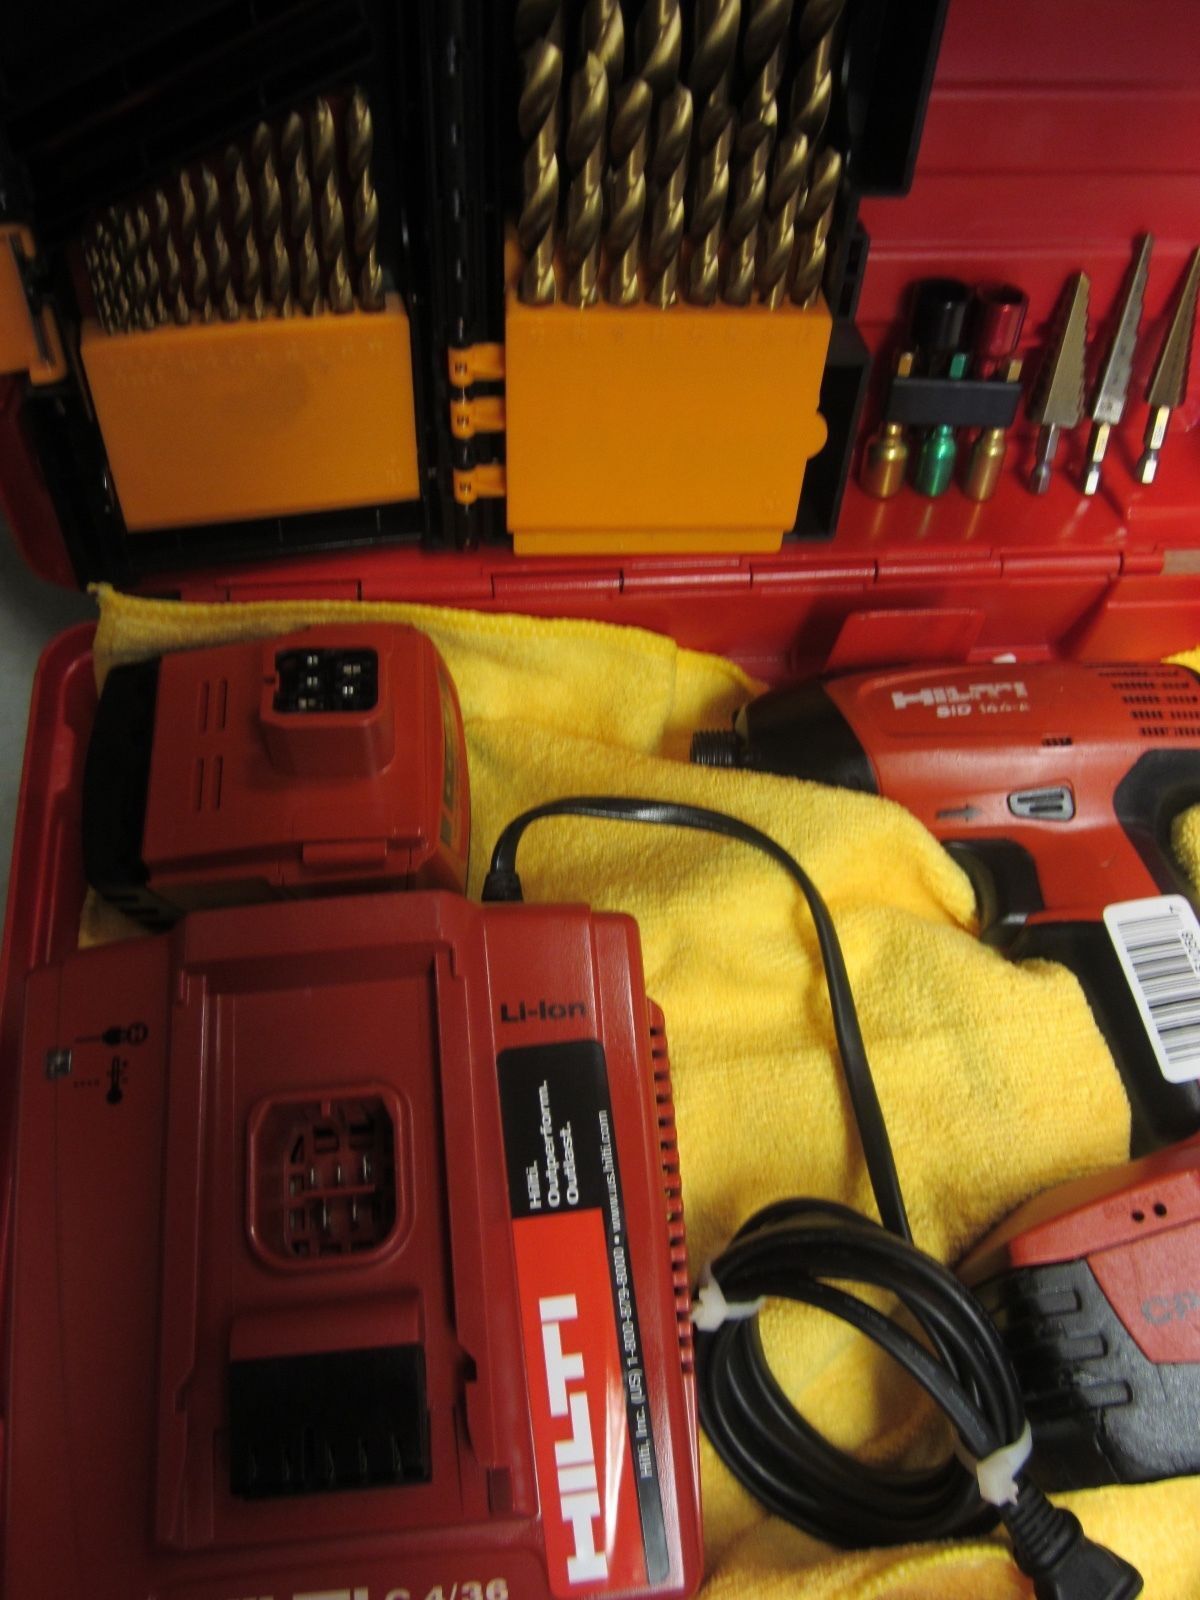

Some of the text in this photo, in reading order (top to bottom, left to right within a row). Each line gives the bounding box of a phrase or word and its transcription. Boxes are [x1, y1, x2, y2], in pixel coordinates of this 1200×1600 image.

[892, 681, 1027, 710] HILTI
[937, 704, 972, 718] SID
[501, 1001, 585, 1022] Li-Ion
[538, 1080, 561, 1208] Outperform.
[560, 1120, 579, 1206] Outlast.
[627, 1367, 646, 1404] (US)
[539, 1294, 608, 1584] HILTI
